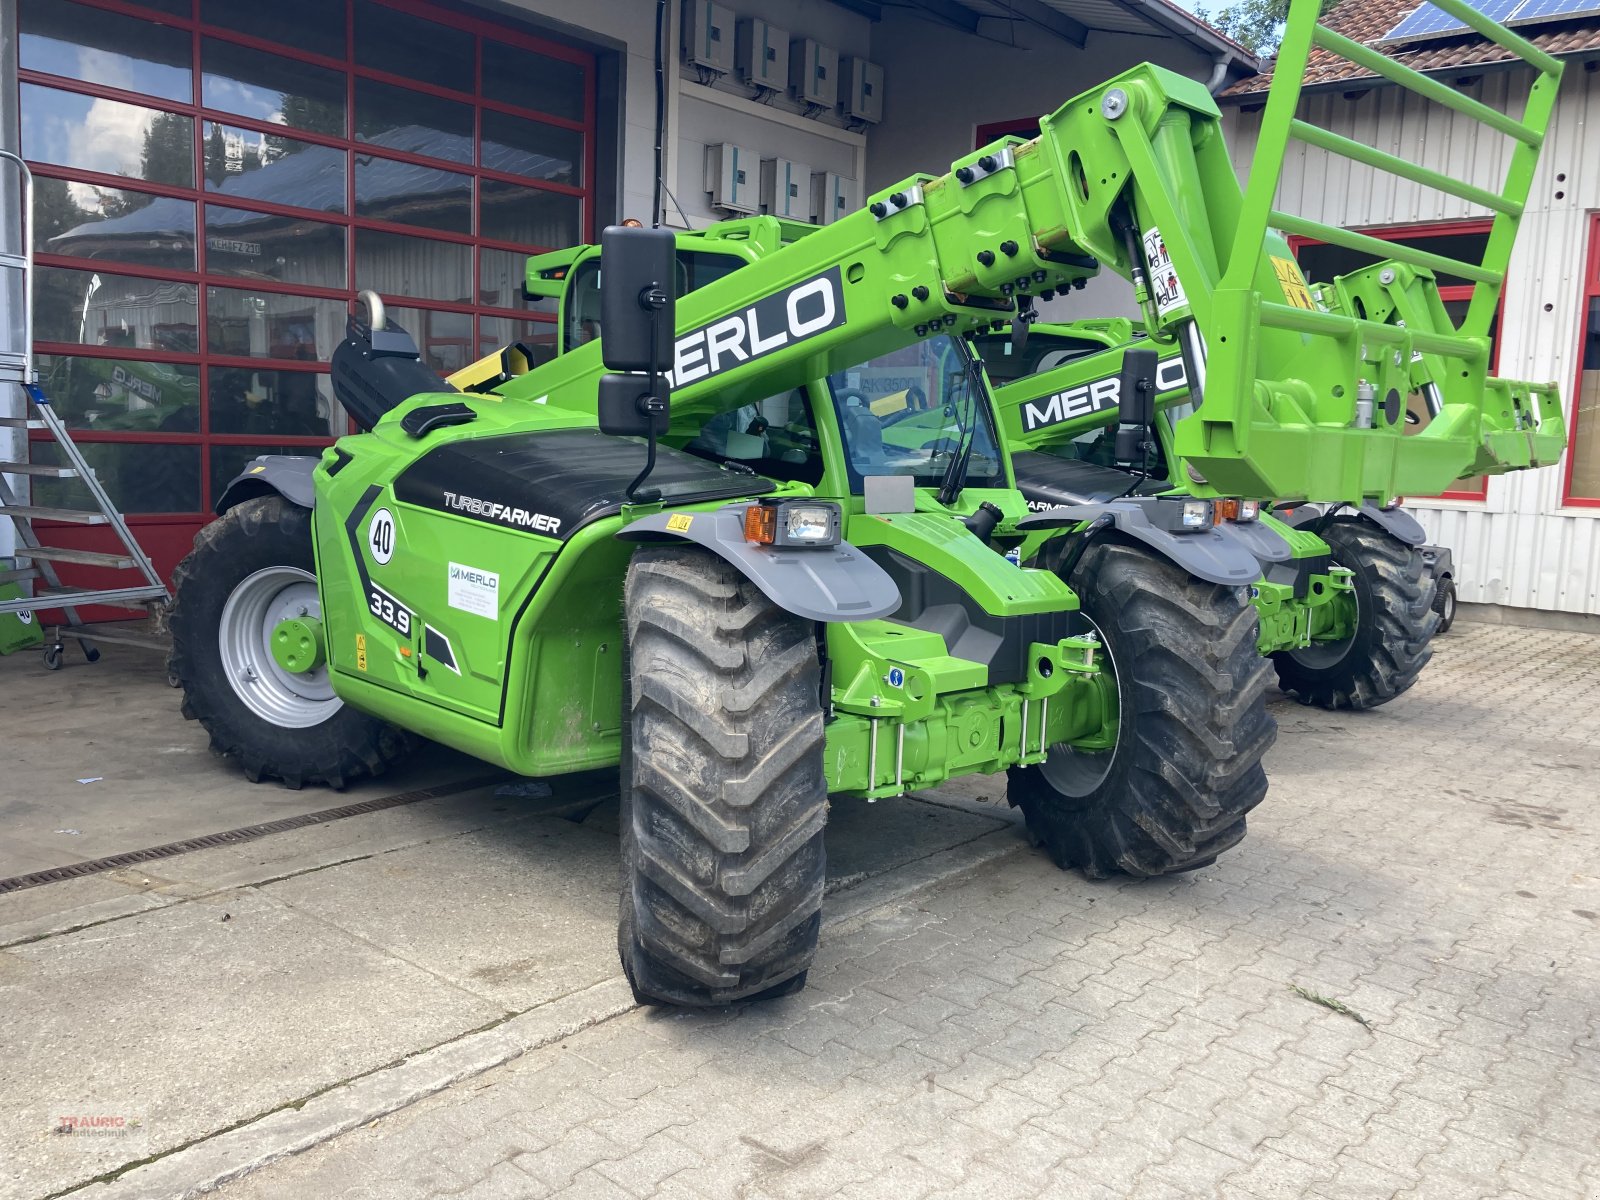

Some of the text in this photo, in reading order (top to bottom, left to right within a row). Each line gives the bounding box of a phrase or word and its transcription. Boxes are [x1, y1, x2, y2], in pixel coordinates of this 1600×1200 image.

[663, 277, 836, 389] ERLO
[1025, 357, 1188, 430] MERO
[443, 491, 561, 534] TURBOFARMER
[1026, 500, 1072, 512] ARM
[373, 519, 391, 555] 40
[461, 569, 497, 589] MERLO
[370, 592, 410, 634] 33.9
